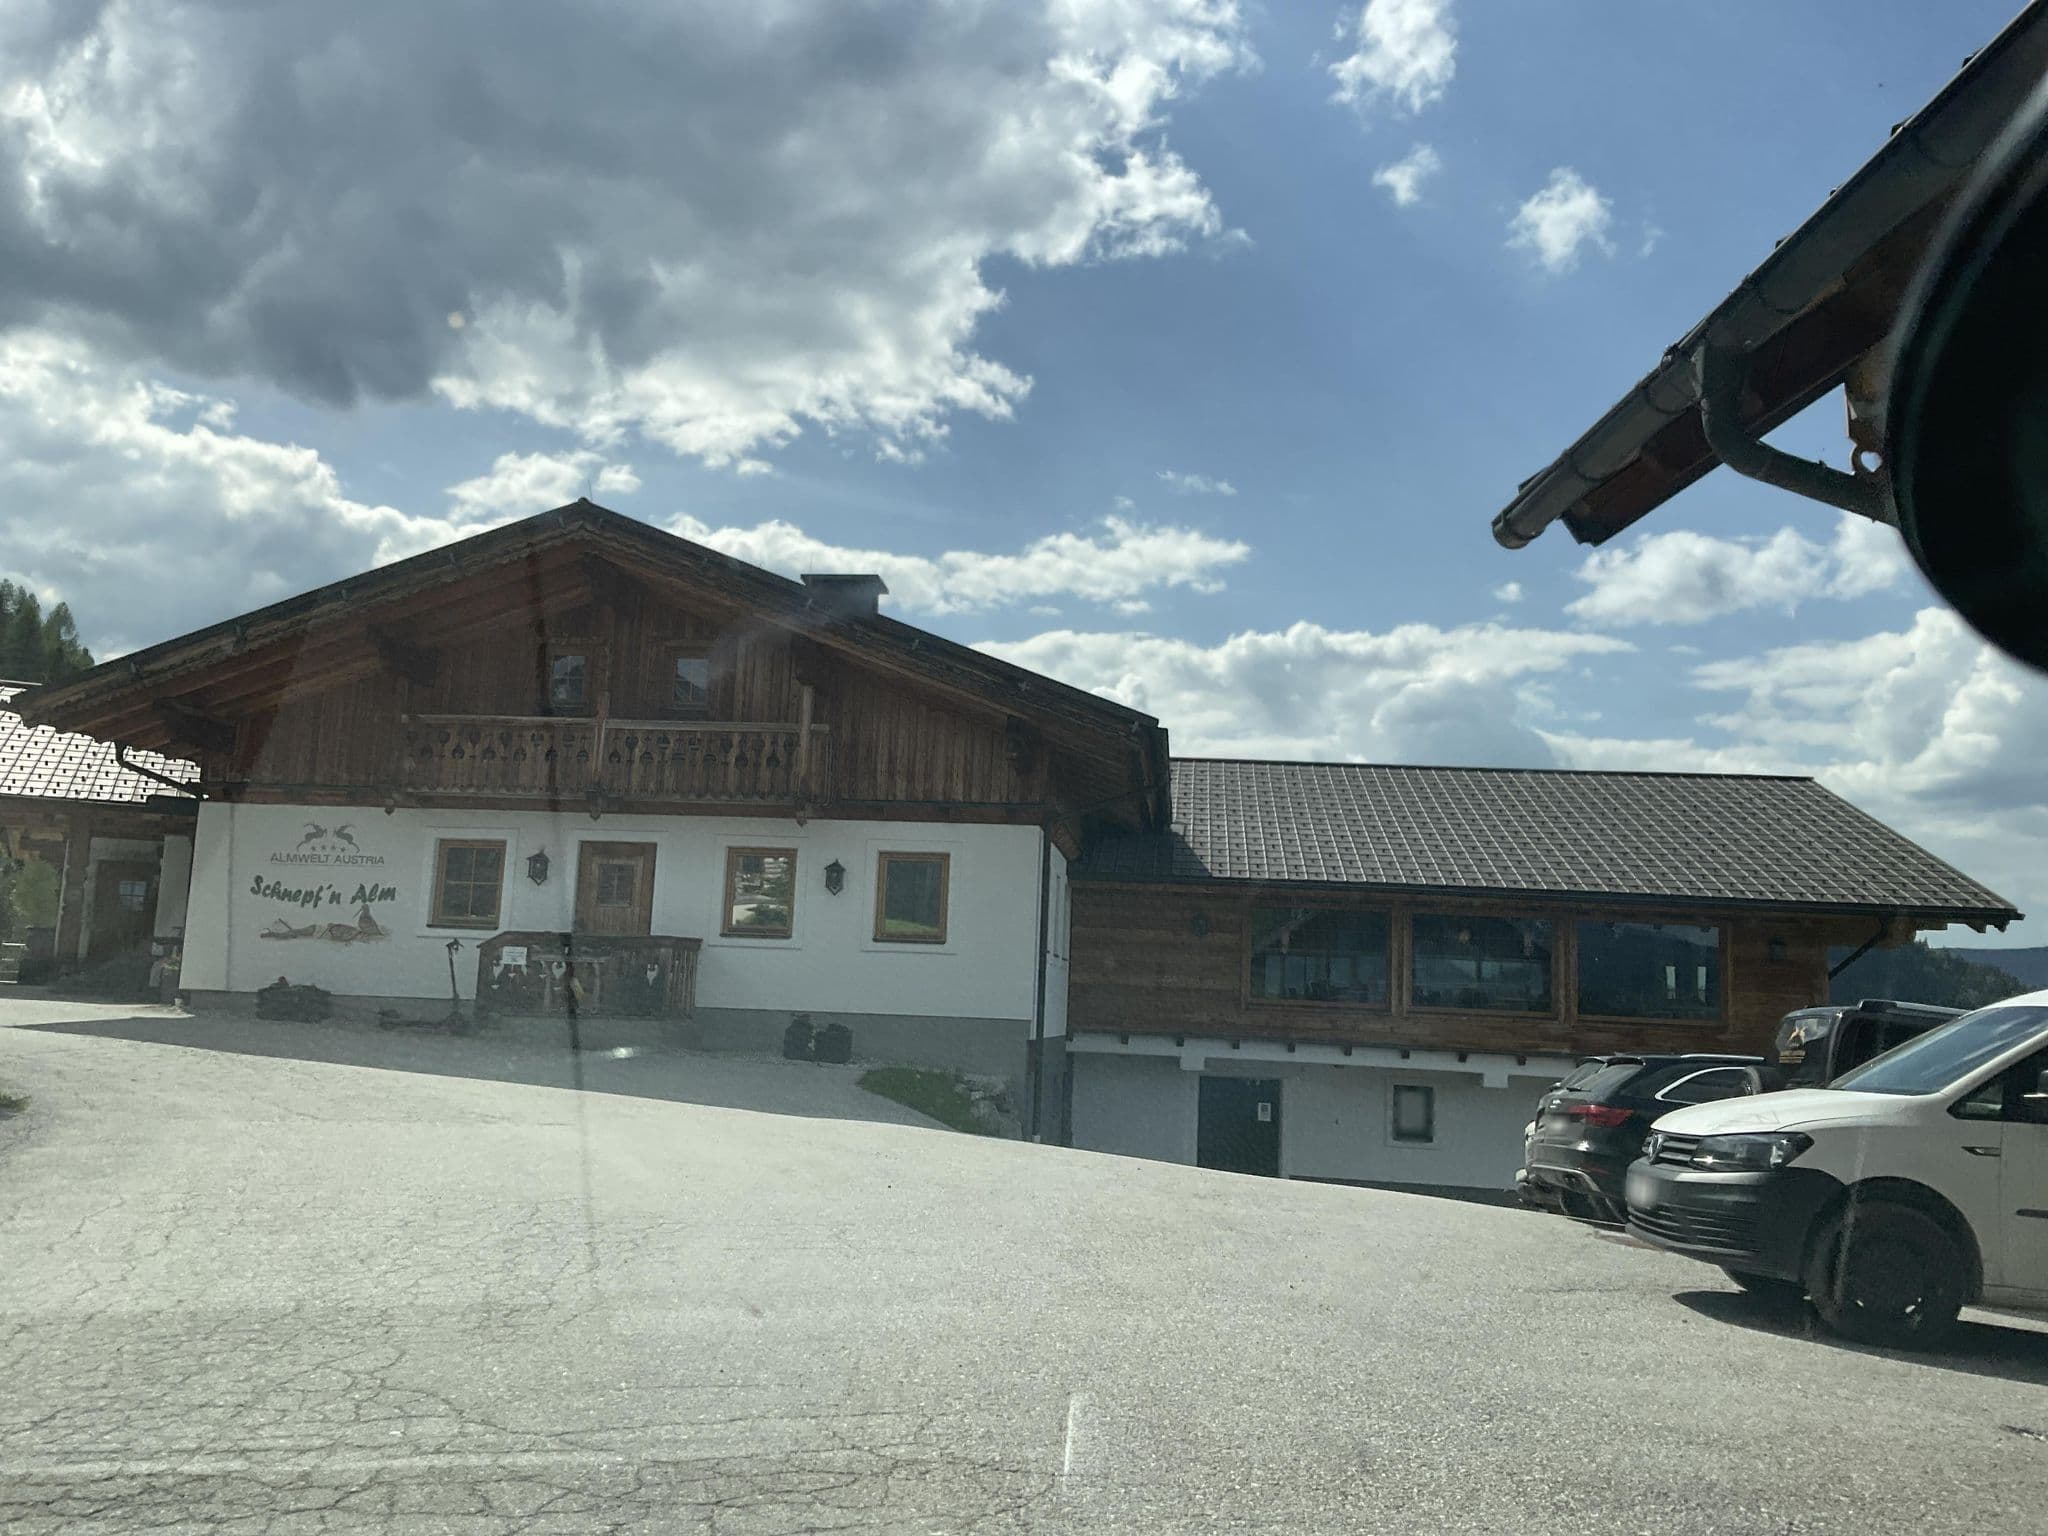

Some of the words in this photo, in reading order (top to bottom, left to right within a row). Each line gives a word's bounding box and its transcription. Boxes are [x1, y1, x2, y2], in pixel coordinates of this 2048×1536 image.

[270, 851, 330, 864] ALMWELT
[334, 855, 385, 865] AUSTRIA
[350, 883, 396, 904] Alm
